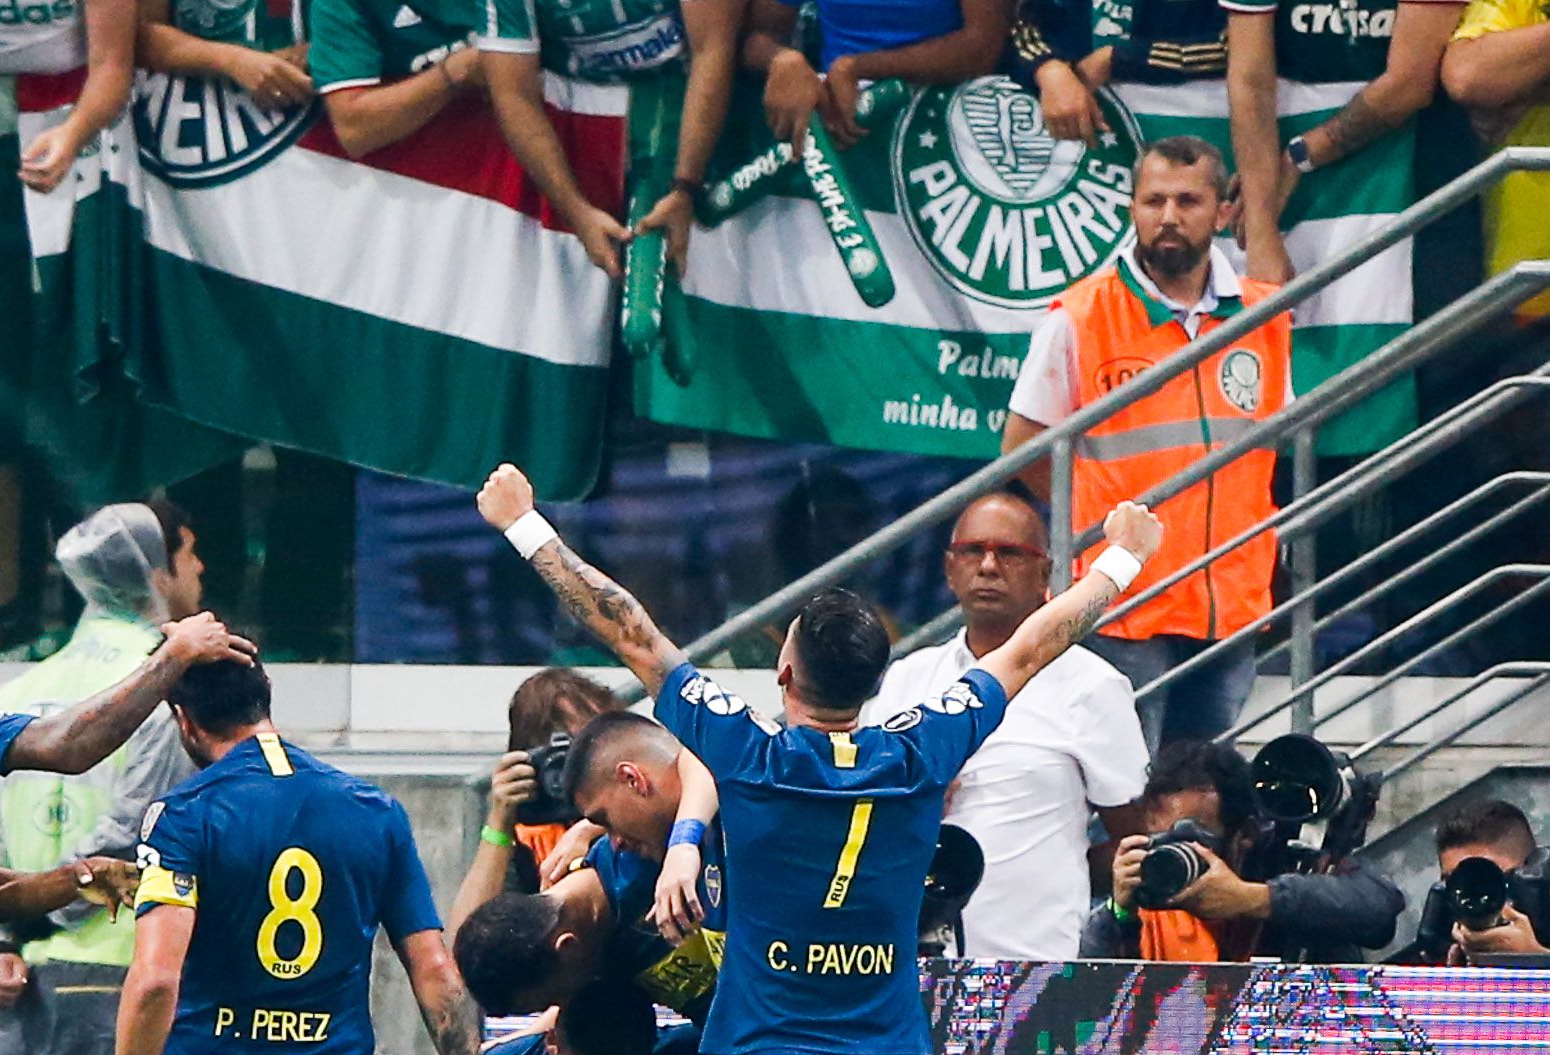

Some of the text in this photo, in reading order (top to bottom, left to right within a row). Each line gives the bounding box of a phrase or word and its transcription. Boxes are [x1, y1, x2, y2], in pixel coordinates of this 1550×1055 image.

[909, 158, 1133, 291] PALMEIRAS
[883, 393, 978, 431] minha
[830, 875, 849, 902] RUS
[256, 847, 323, 979] 8
[272, 963, 301, 975] RUS
[768, 941, 894, 975] C. PAVON
[215, 1008, 331, 1042] P. PEREZ
